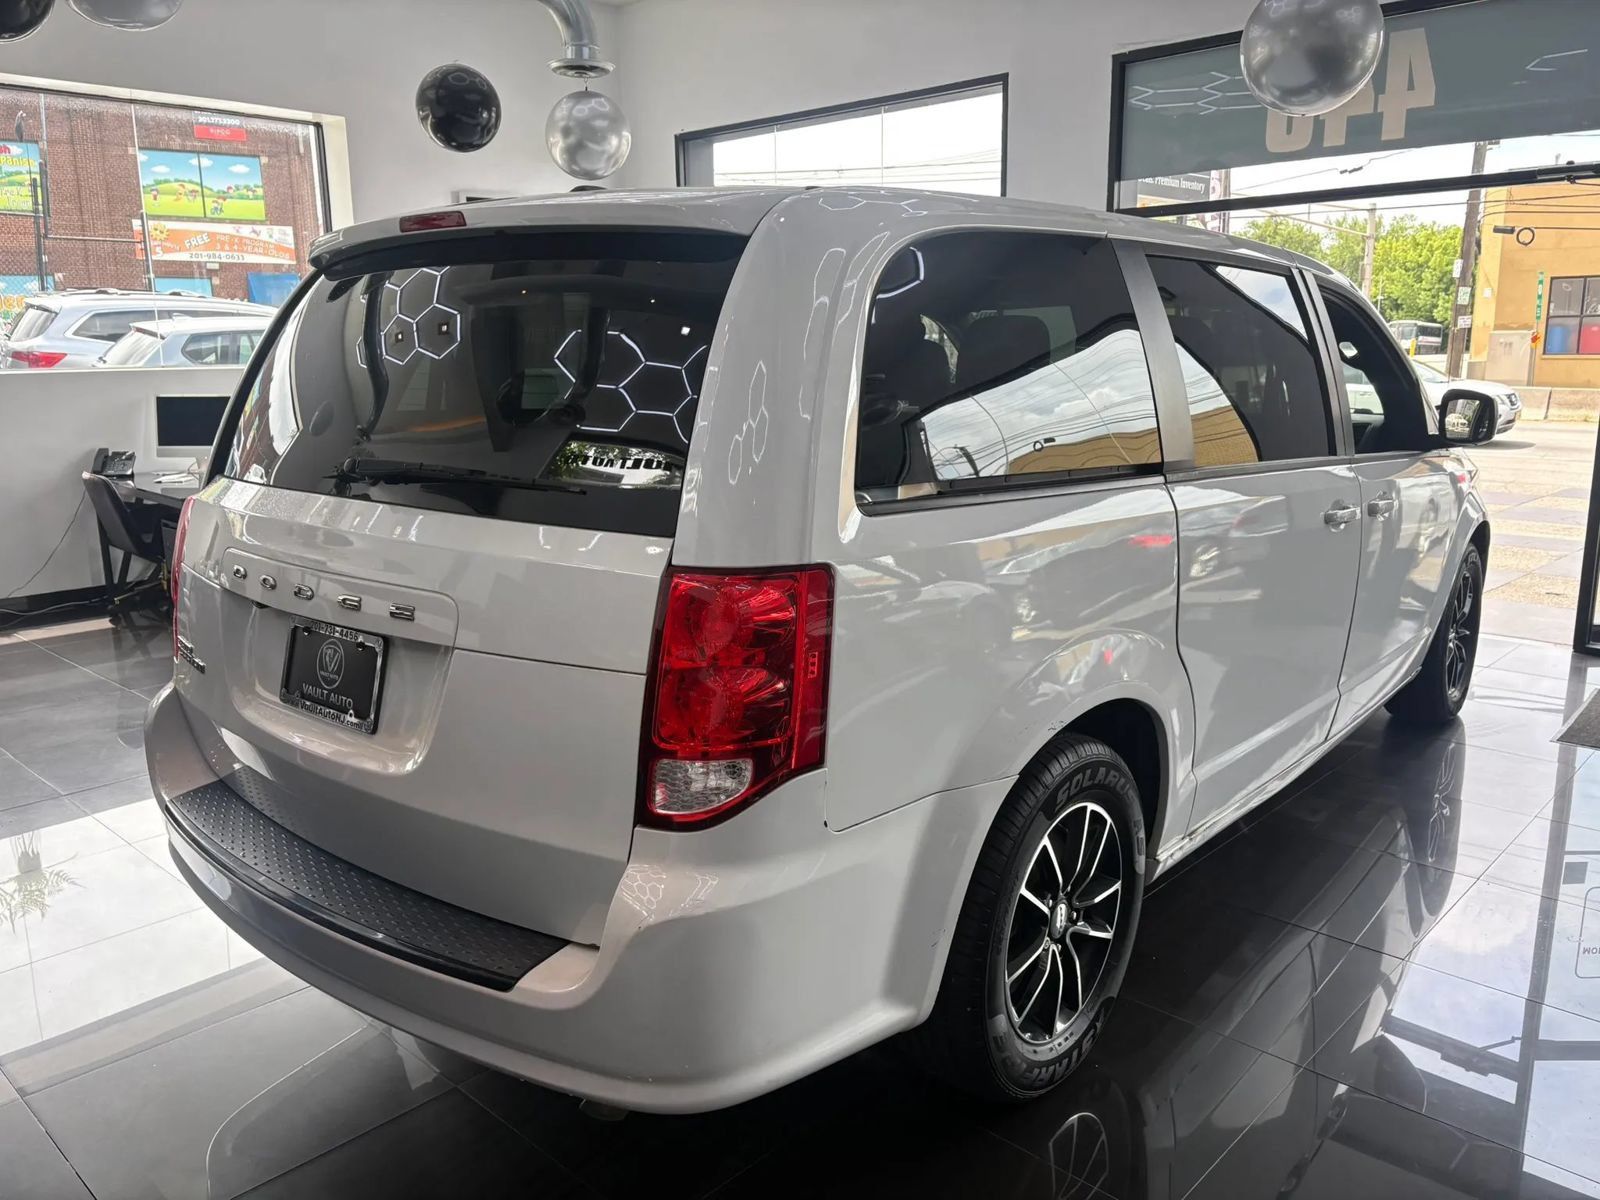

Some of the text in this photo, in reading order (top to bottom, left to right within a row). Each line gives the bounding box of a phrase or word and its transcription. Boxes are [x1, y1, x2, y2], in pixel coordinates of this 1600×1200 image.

[1180, 178, 1206, 193] Inventory
[184, 232, 211, 250] FREE
[232, 564, 416, 622] DODGE
[310, 620, 359, 641] 201-731-4456
[302, 682, 354, 709] VAULT AUTO
[1055, 766, 1137, 813] SOLARUS
